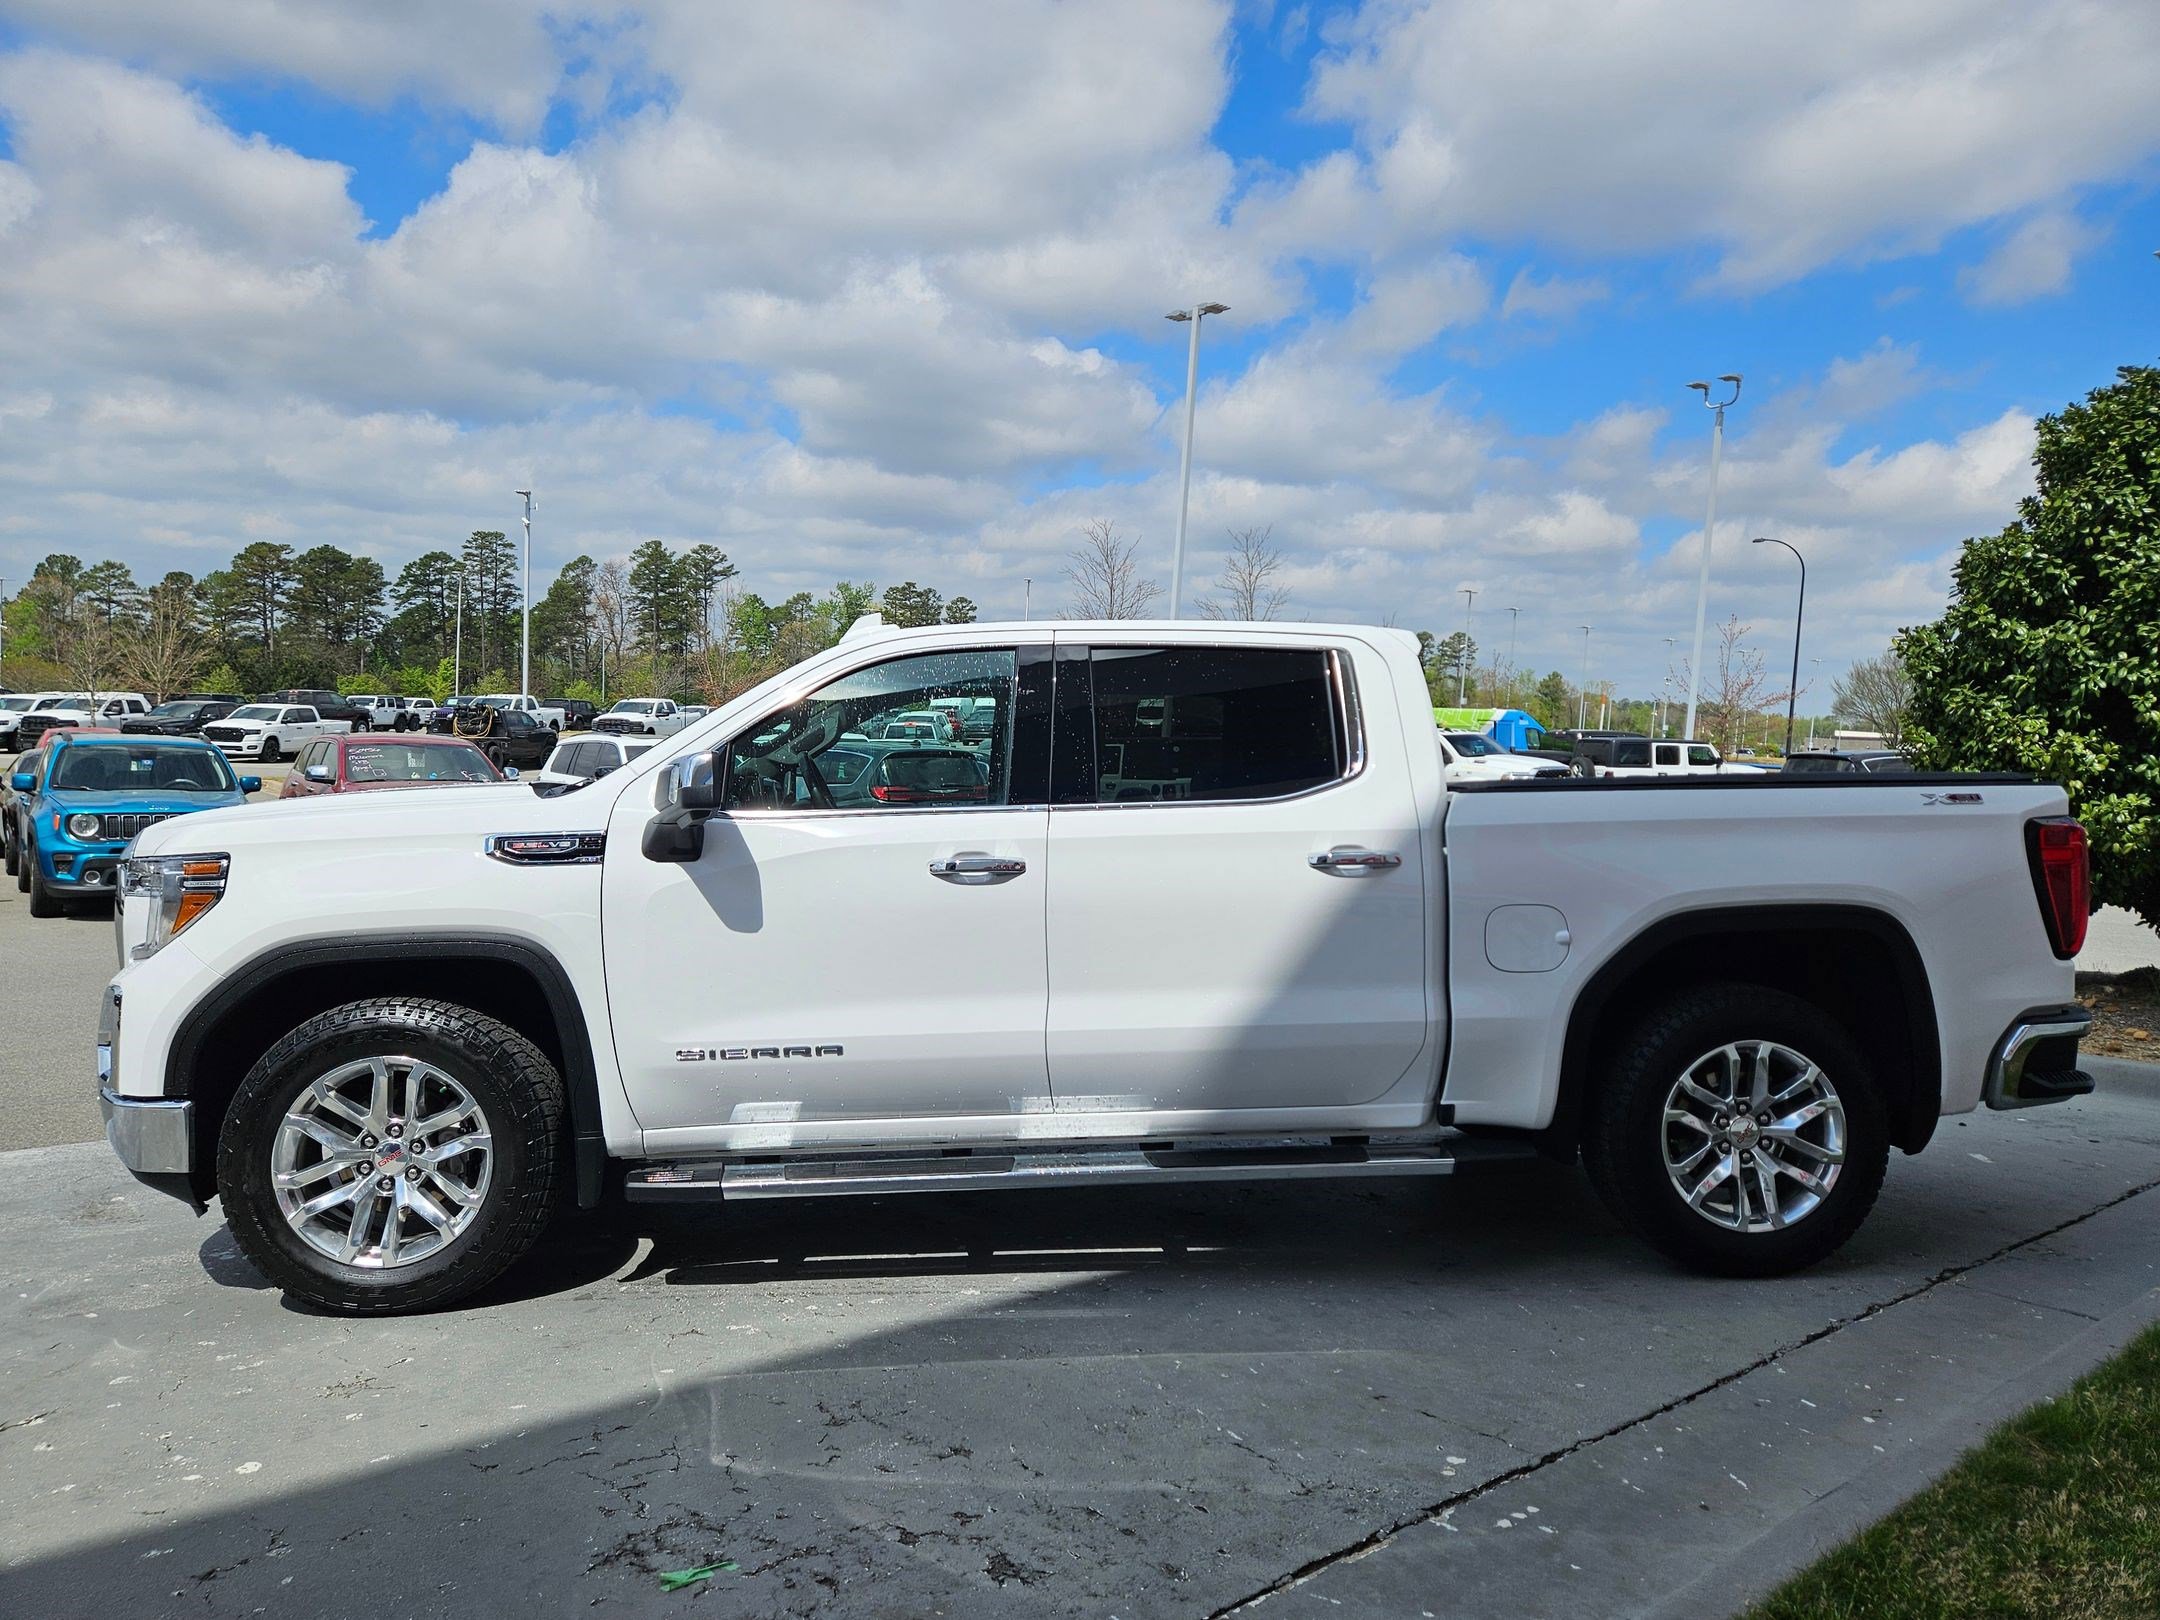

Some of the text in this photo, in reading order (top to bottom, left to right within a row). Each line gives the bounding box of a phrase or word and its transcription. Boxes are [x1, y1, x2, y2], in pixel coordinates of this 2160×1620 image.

[675, 1044, 844, 1062] SIERRA
[1737, 1119, 1754, 1143] GMC
[377, 1149, 405, 1167] GMC
